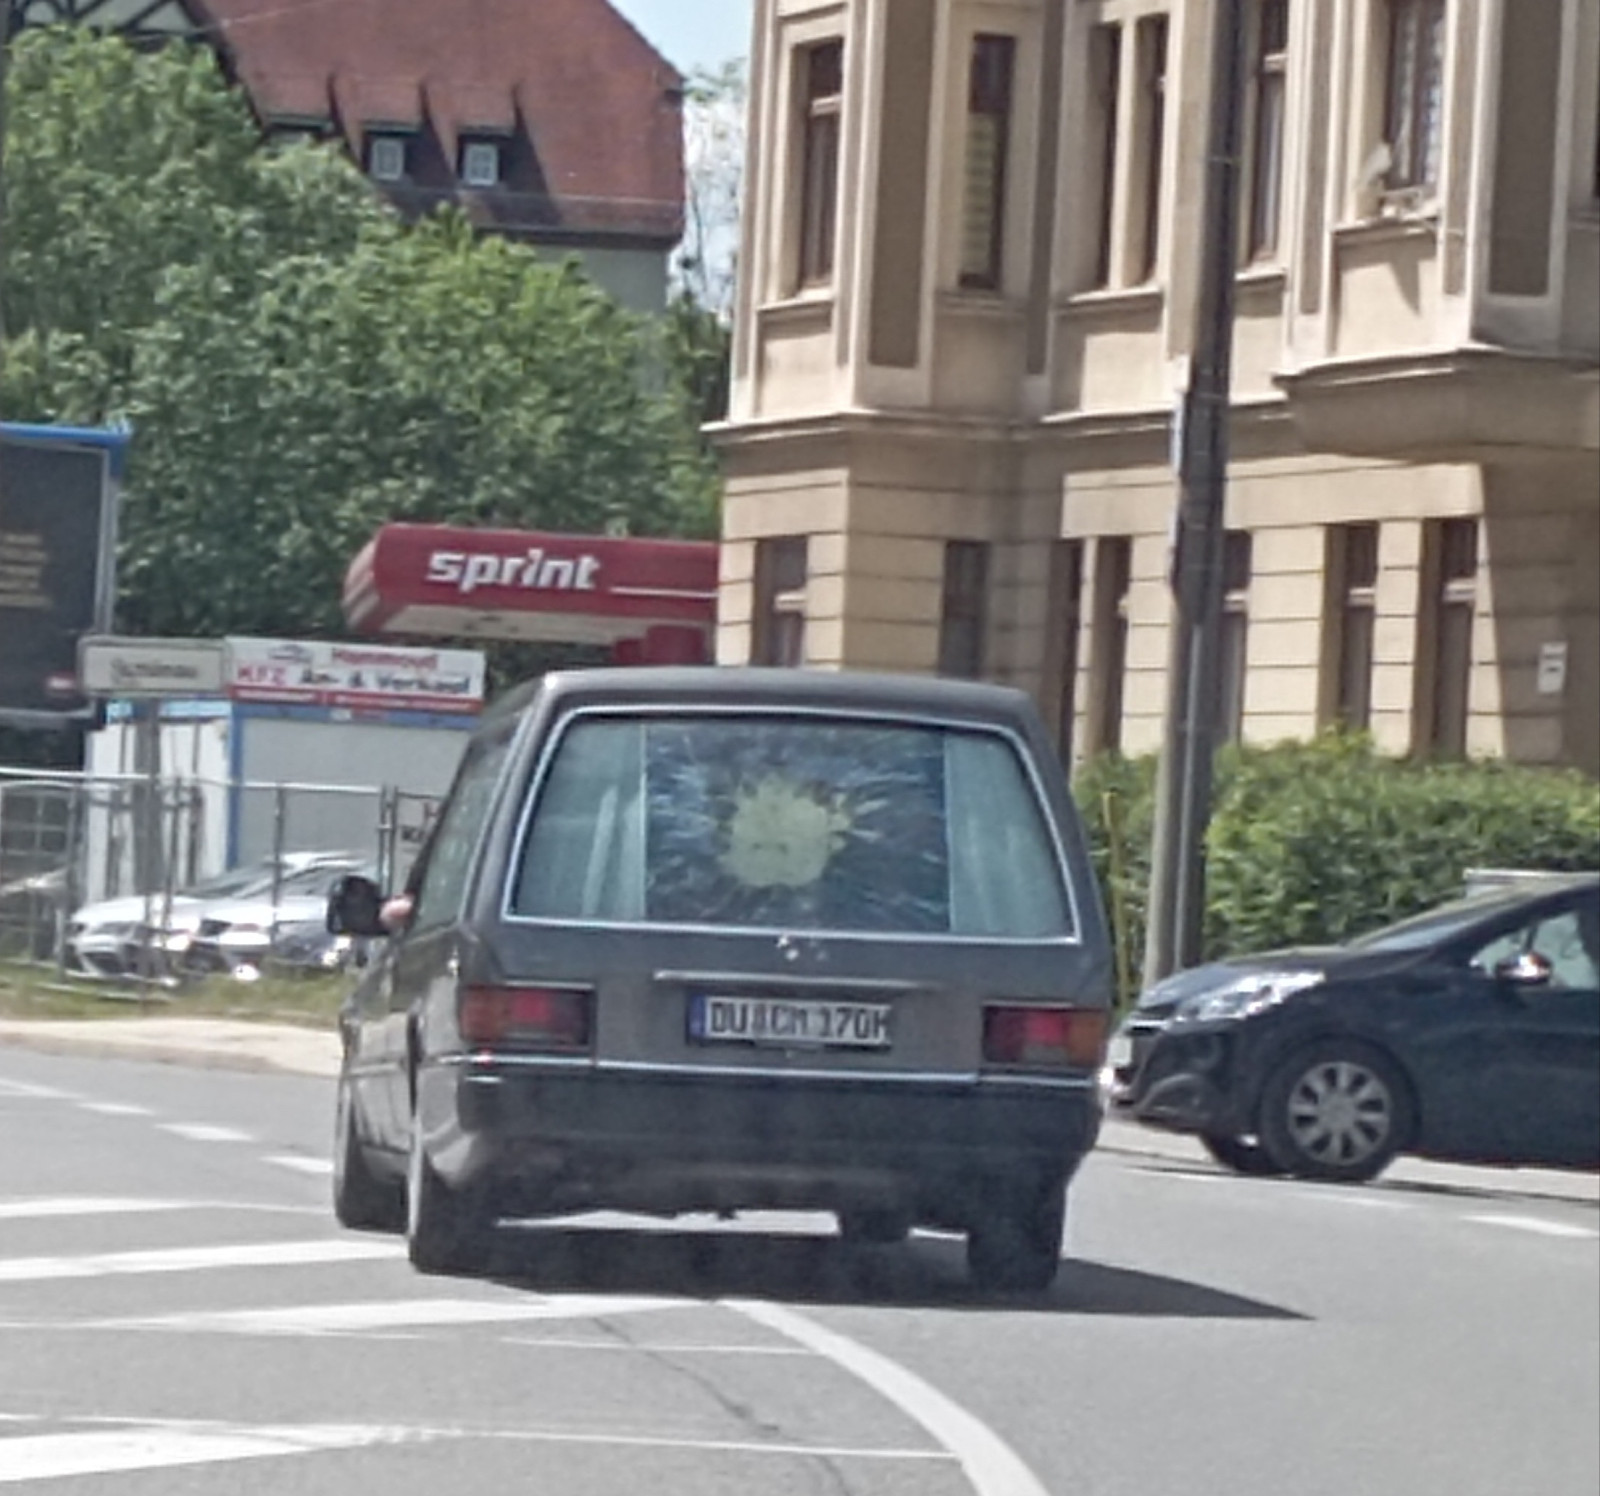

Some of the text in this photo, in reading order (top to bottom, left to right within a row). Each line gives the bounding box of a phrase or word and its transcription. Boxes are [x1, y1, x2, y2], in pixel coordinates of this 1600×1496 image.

[427, 548, 600, 592] sprint
[237, 664, 287, 687] KFZ
[377, 674, 471, 695] Verkauf
[710, 1002, 748, 1033] DU
